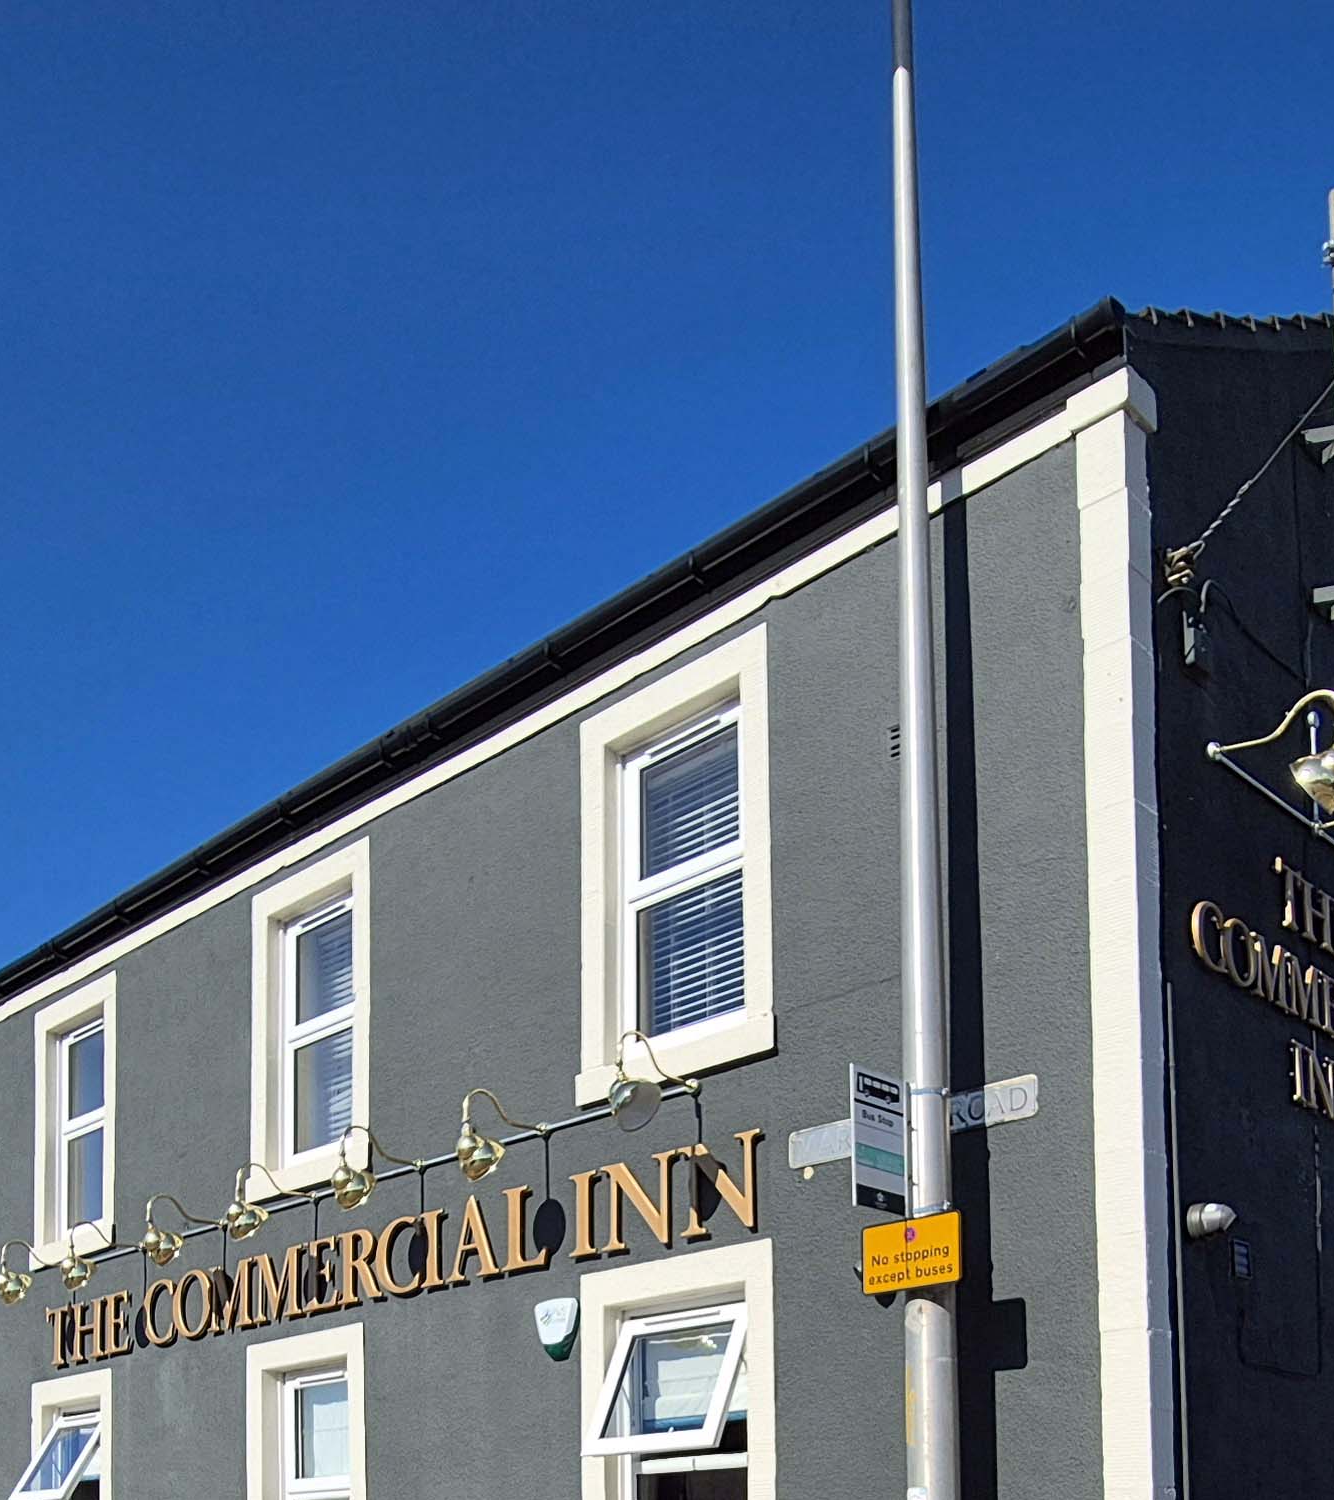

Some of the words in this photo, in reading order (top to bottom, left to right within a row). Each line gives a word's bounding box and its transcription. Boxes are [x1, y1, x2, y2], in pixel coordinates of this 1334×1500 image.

[949, 1086, 1028, 1126] ROAD
[861, 1109, 876, 1123] Bus
[877, 1113, 895, 1129] Stop
[45, 1289, 135, 1369] THE
[142, 1184, 550, 1346] COMMERCIAL
[569, 1127, 764, 1258] INN
[871, 1255, 889, 1267] No
[893, 1245, 950, 1263] stopping
[868, 1269, 911, 1286] except
[915, 1263, 954, 1279] buses
